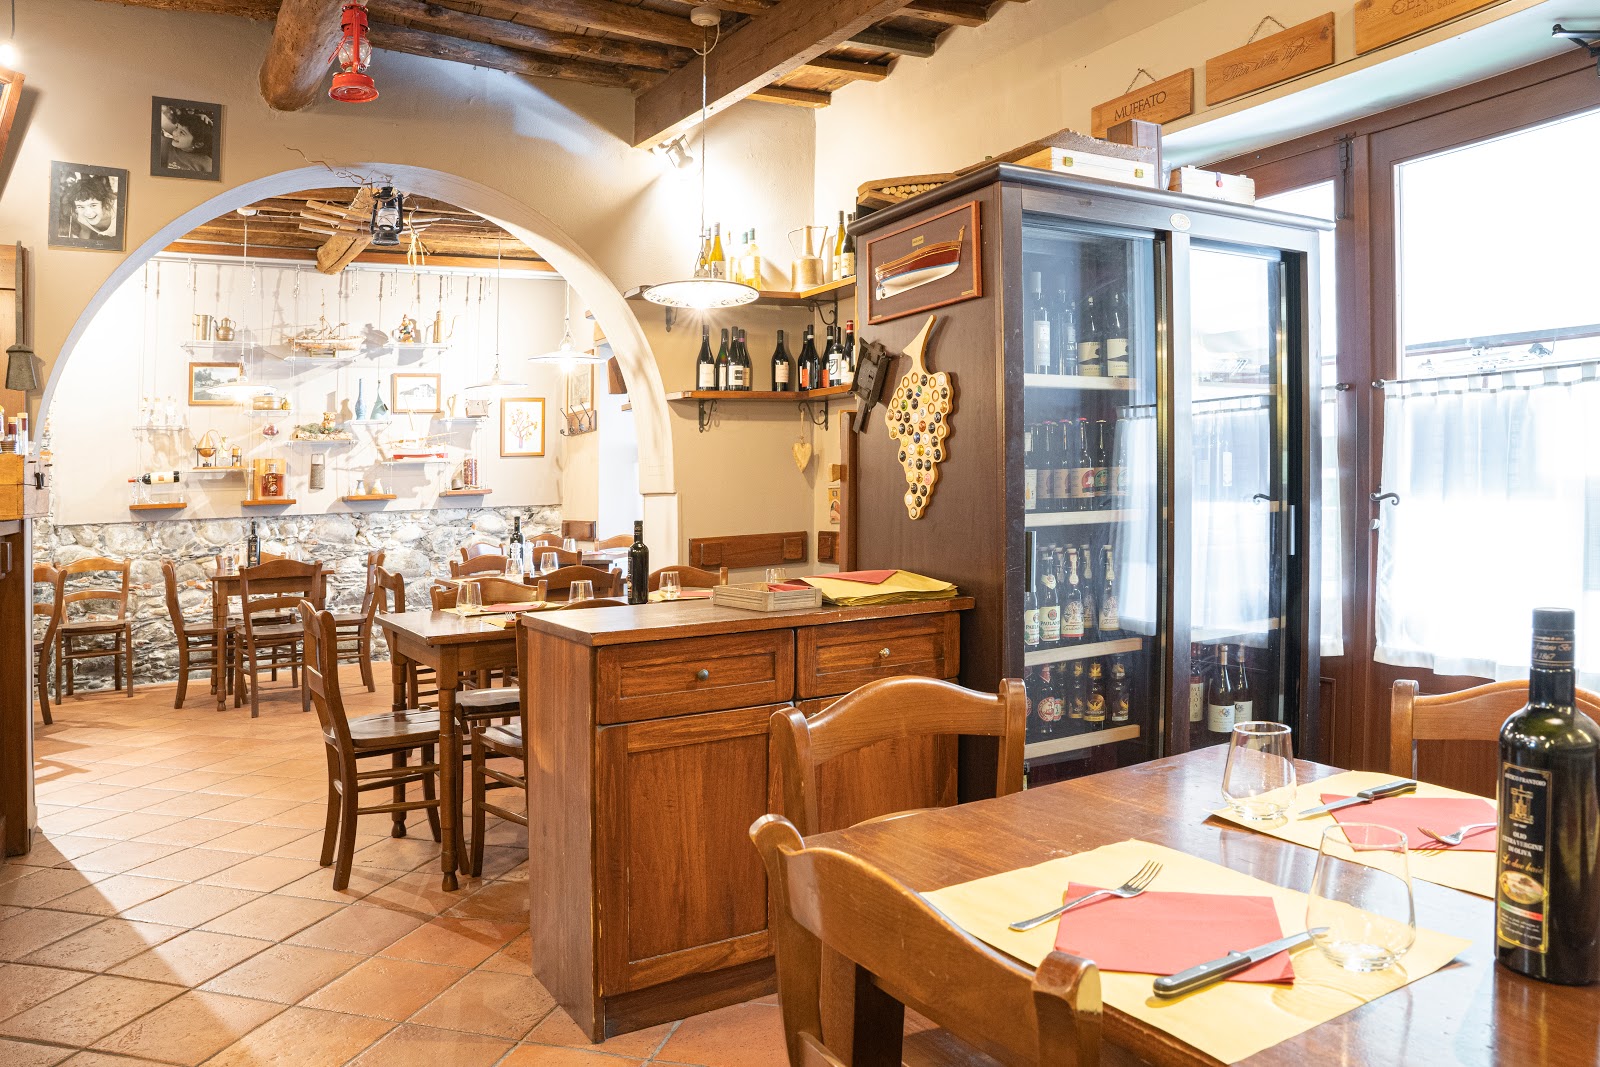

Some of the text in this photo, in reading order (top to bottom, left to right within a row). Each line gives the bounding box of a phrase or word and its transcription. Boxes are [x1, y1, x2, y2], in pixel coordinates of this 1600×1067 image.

[1412, 4, 1434, 18] della
[1114, 90, 1167, 122] MUFFATO
[1512, 830, 1527, 841] OLIO
[1516, 838, 1544, 852] VERGINE
[1514, 847, 1532, 858] OLIVA
